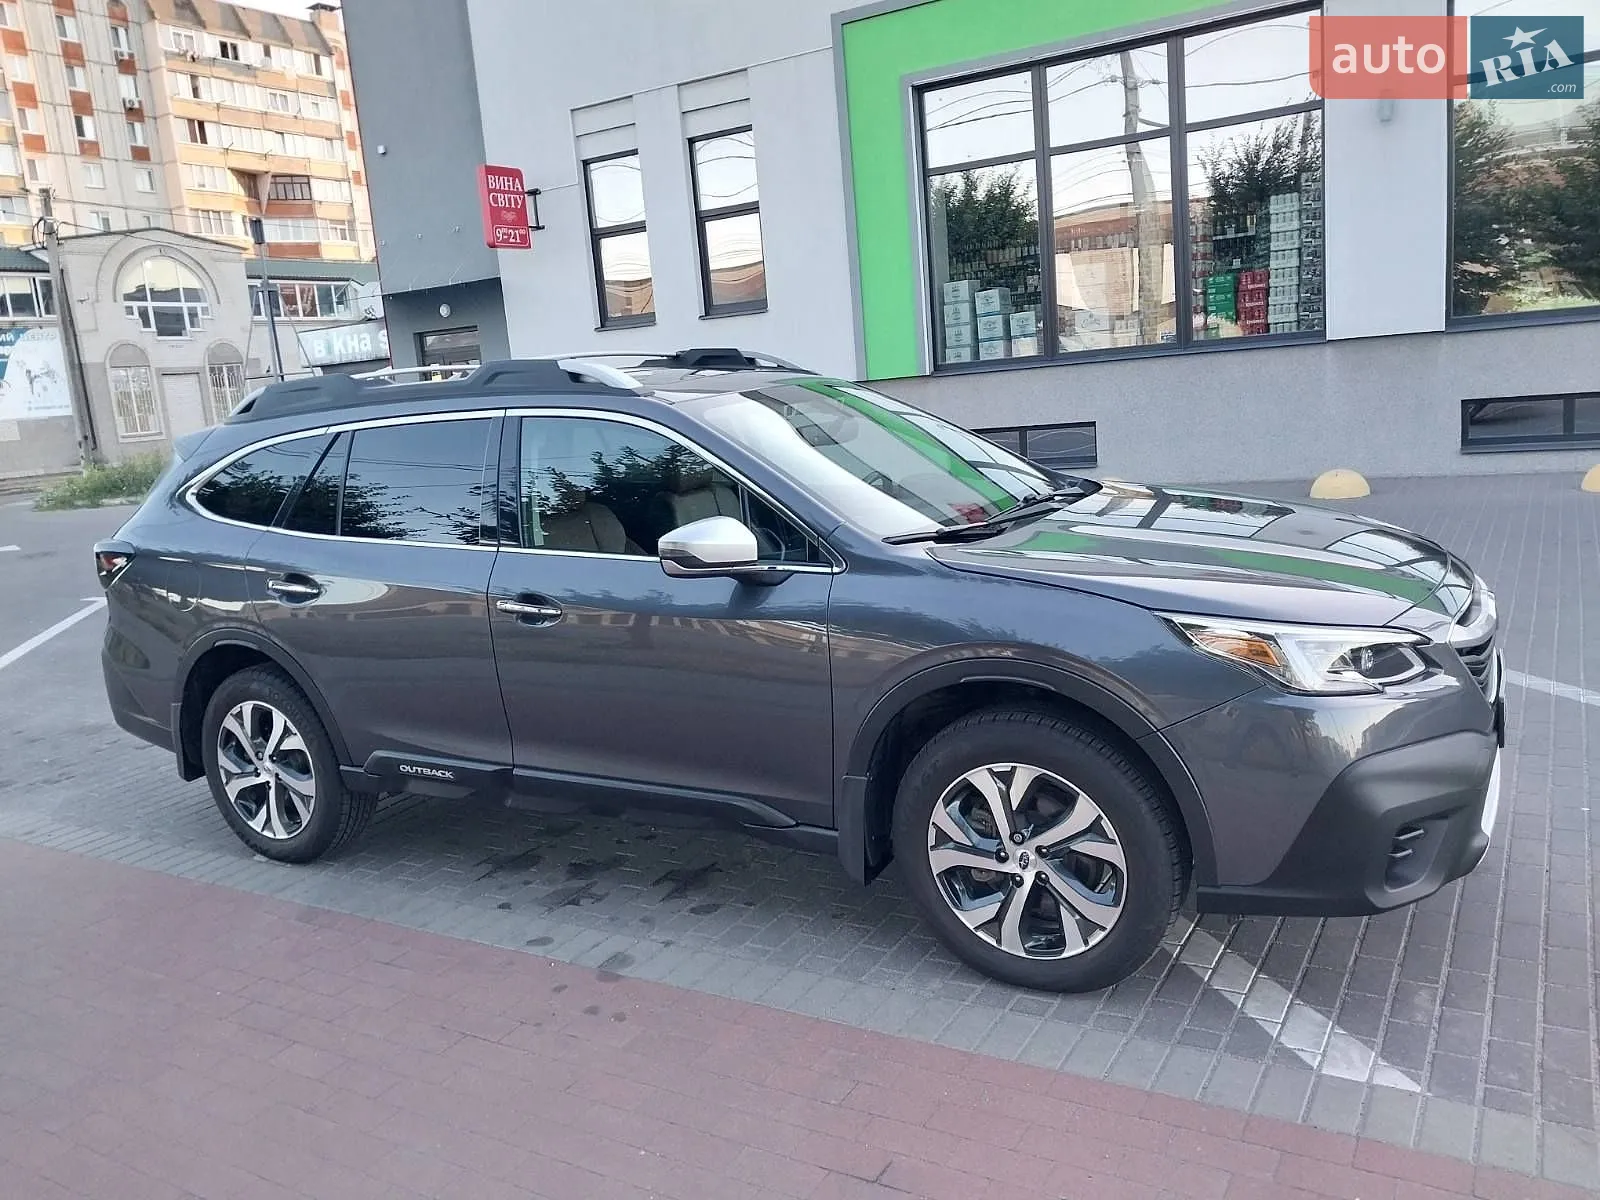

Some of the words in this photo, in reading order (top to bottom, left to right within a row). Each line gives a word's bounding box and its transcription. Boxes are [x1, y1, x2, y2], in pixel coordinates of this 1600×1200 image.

[487, 174, 523, 192] ВИНА
[489, 192, 524, 209] СВІТУ
[399, 764, 455, 779] OUTBACK
